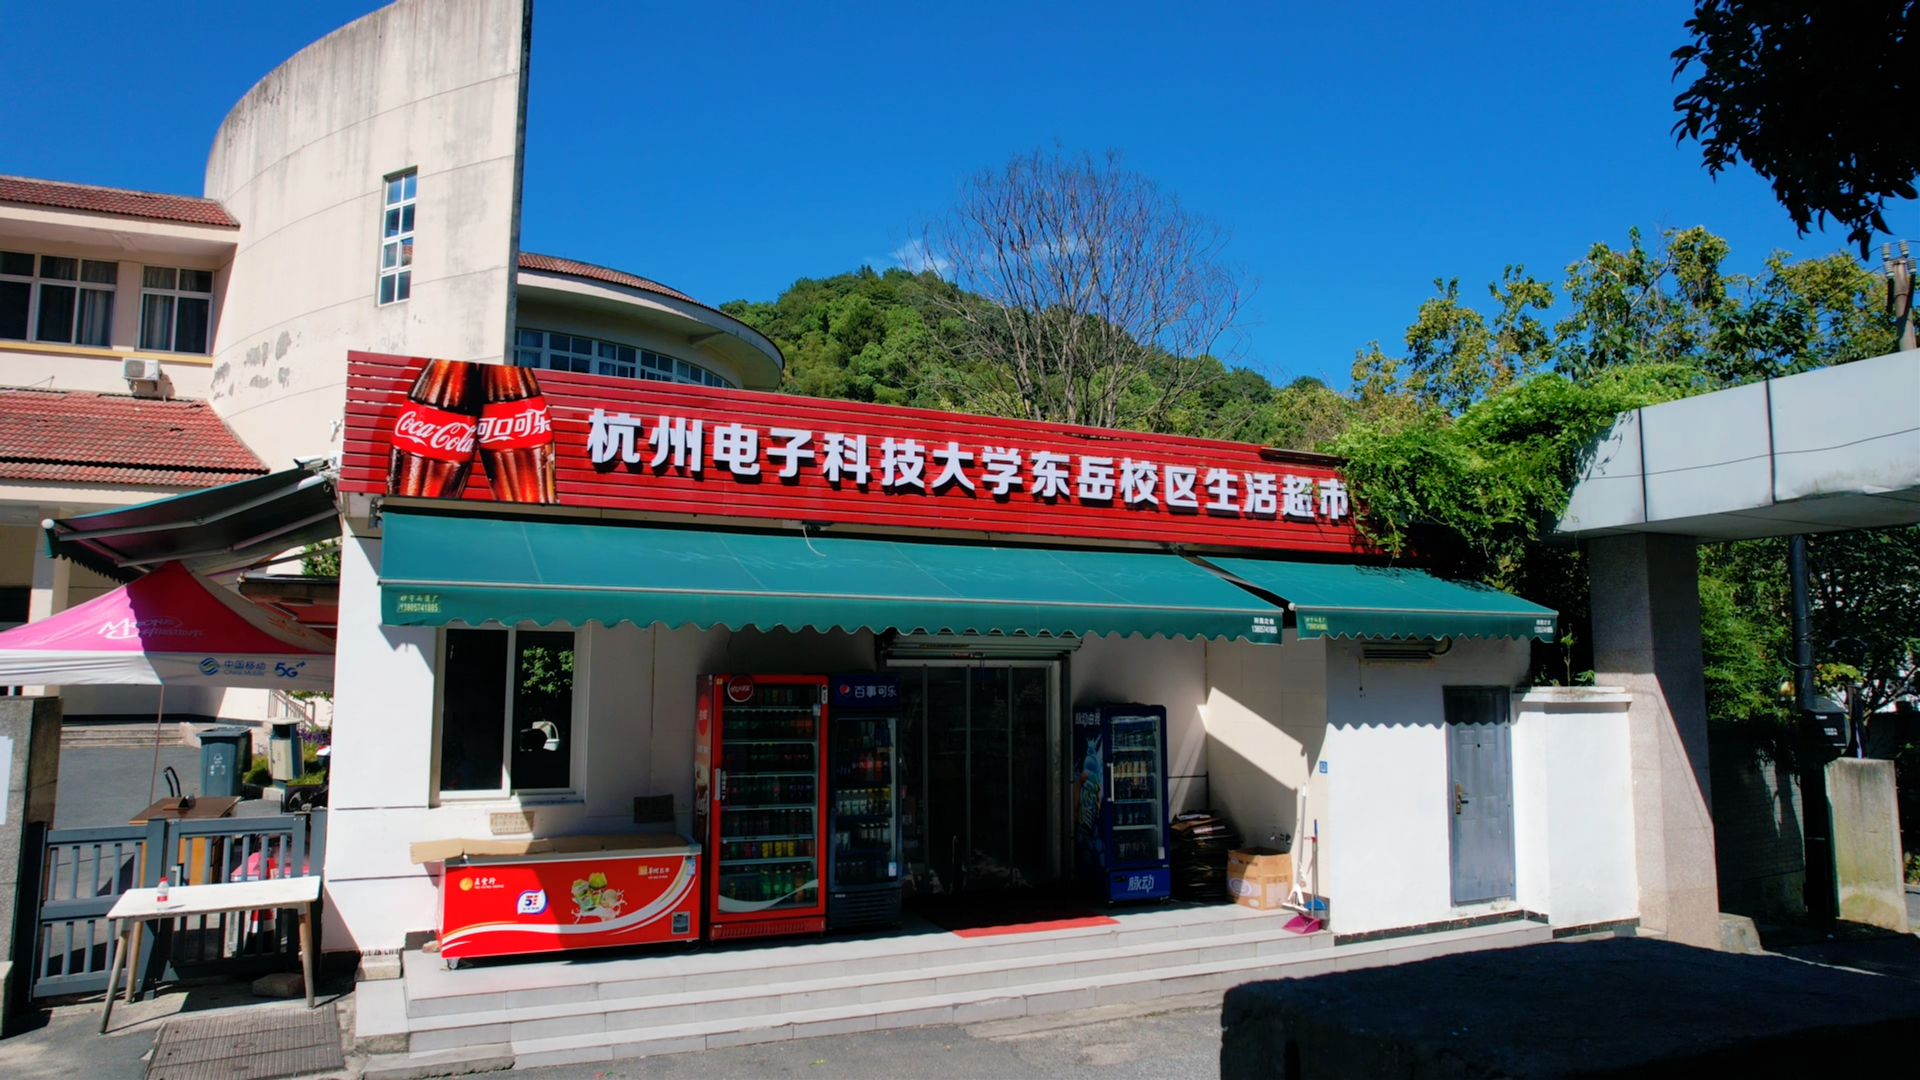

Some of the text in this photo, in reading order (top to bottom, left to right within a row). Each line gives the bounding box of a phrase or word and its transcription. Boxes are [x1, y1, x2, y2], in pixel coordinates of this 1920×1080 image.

[394, 411, 475, 452] Coca-Cola
[476, 405, 553, 444] 可口可乐
[586, 407, 1350, 521] 杭州电子科技大学东岳校区生活超市
[224, 660, 266, 670] 中国移动
[854, 685, 897, 698] 百事可乐
[1127, 874, 1155, 893] 脉动
